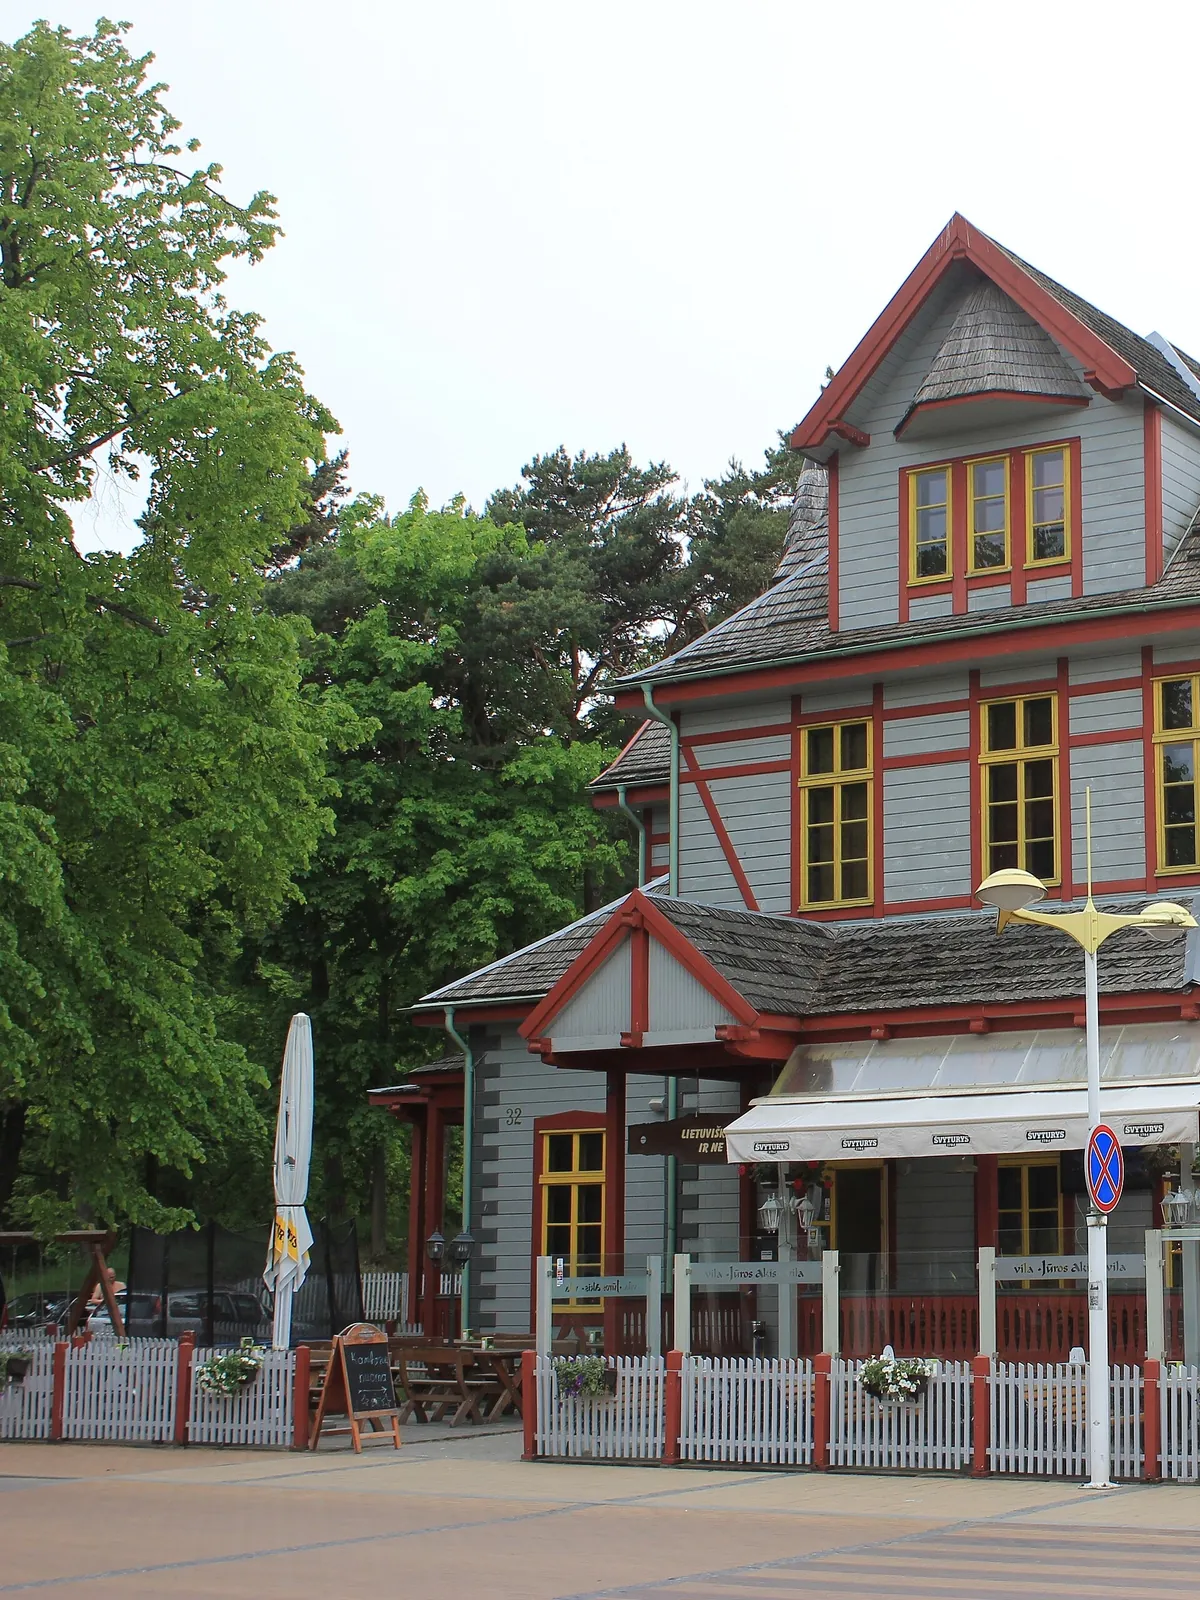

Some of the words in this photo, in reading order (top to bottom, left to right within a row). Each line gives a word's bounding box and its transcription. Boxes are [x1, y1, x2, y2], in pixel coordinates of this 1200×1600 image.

[505, 1107, 522, 1126] 32
[698, 1142, 709, 1154] IR
[710, 1142, 724, 1153] NE
[1013, 1262, 1034, 1274] vila
[1106, 1260, 1127, 1273] vila
